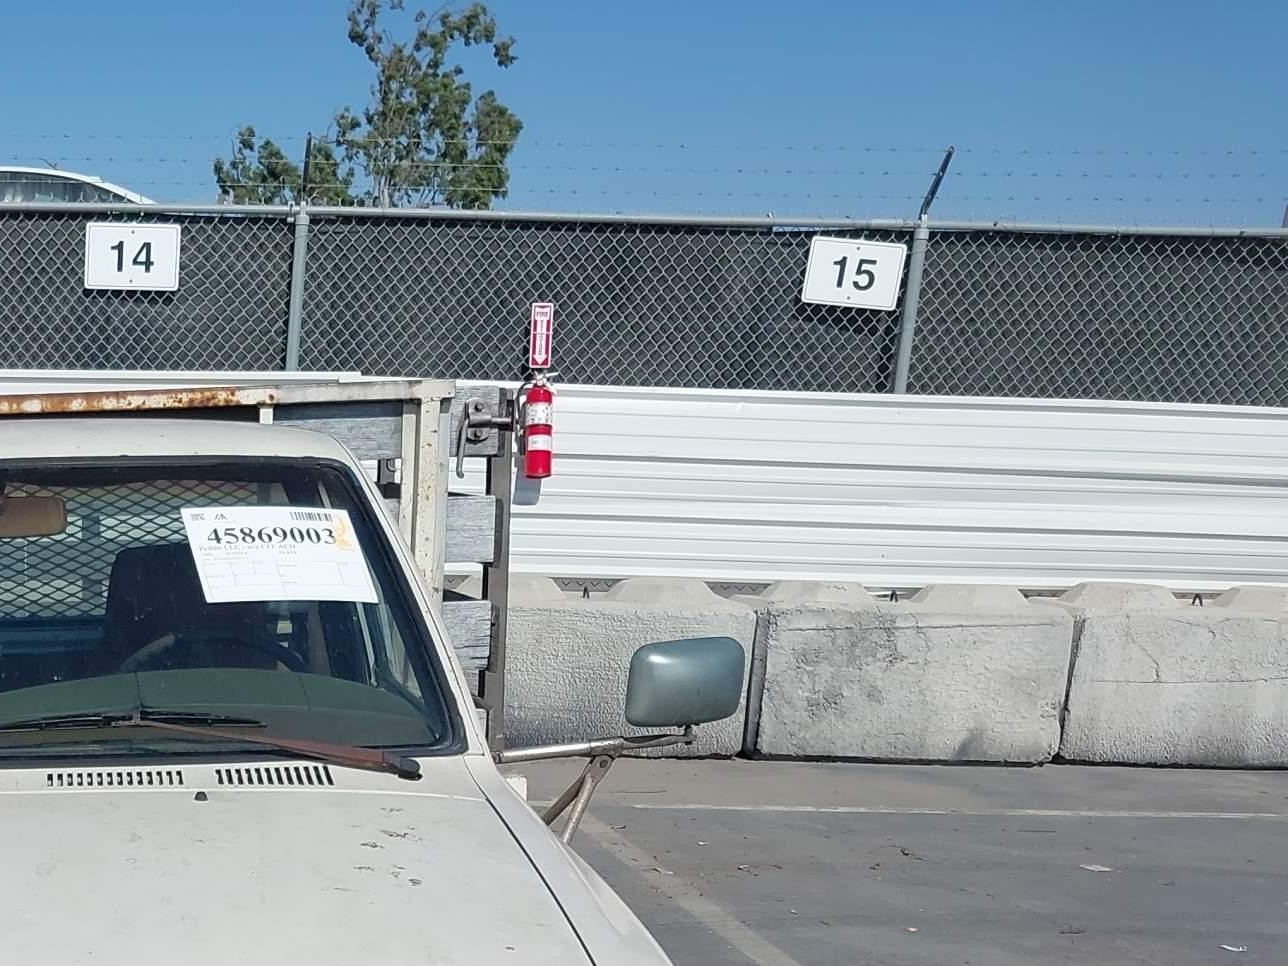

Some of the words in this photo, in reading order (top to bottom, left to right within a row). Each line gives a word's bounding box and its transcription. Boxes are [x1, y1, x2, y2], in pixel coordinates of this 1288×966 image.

[111, 240, 154, 273] 14
[833, 256, 876, 291] 15
[207, 526, 337, 545] 45869003
